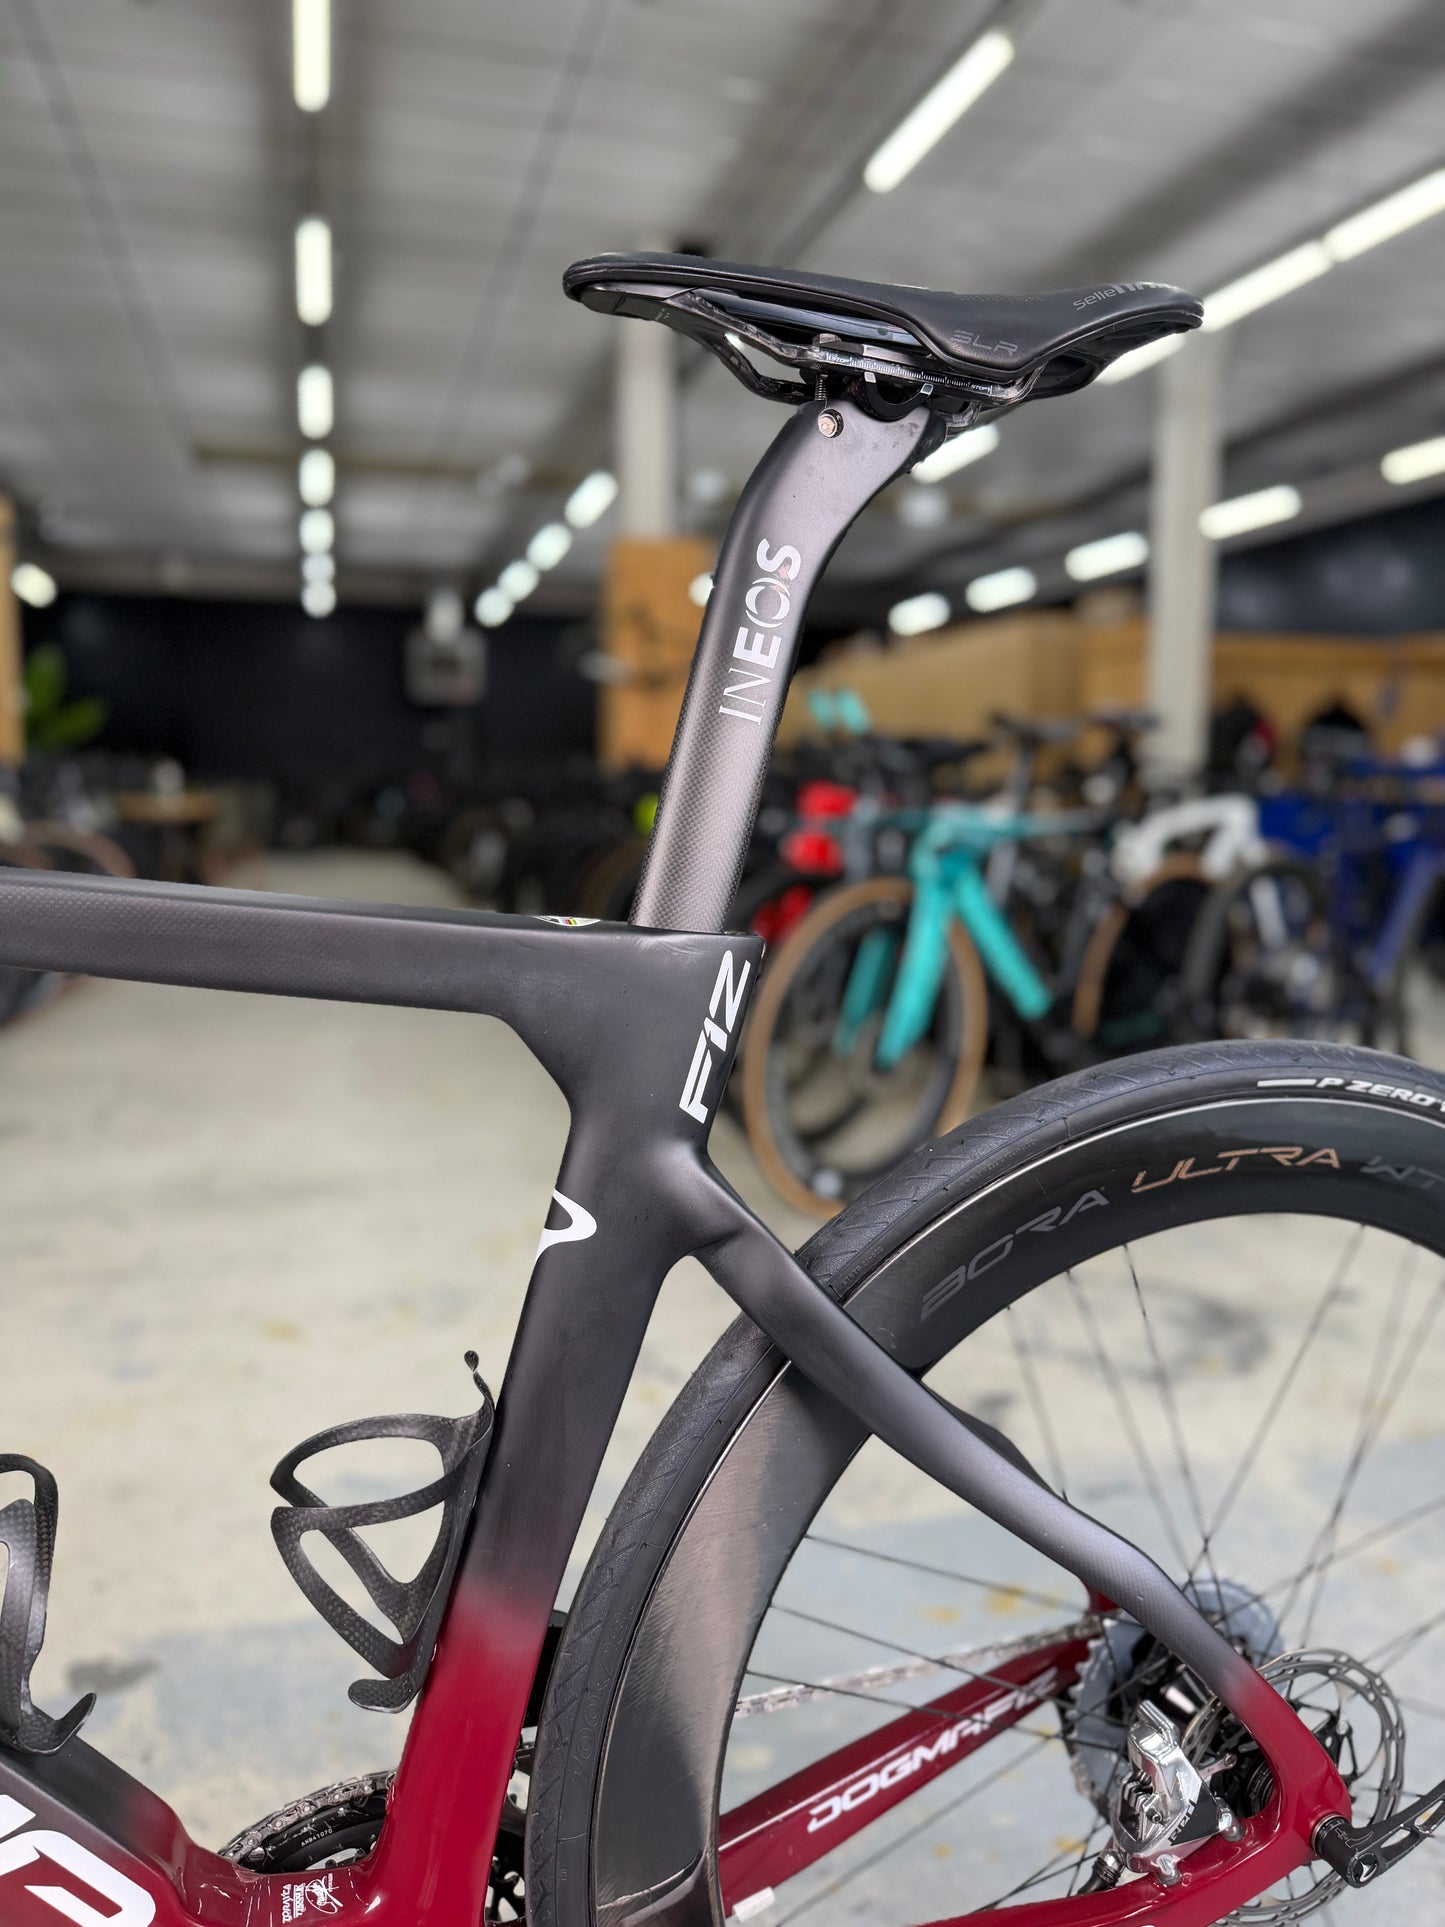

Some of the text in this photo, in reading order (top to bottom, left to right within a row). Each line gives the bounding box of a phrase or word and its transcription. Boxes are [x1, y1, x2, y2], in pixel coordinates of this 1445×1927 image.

[718, 537, 801, 726] INEOS
[679, 949, 751, 1124] F12
[1316, 1076, 1345, 1088] P
[1345, 1079, 1436, 1107] ZERO
[919, 1188, 1110, 1324] BORA
[1130, 1145, 1341, 1194] ULTRA
